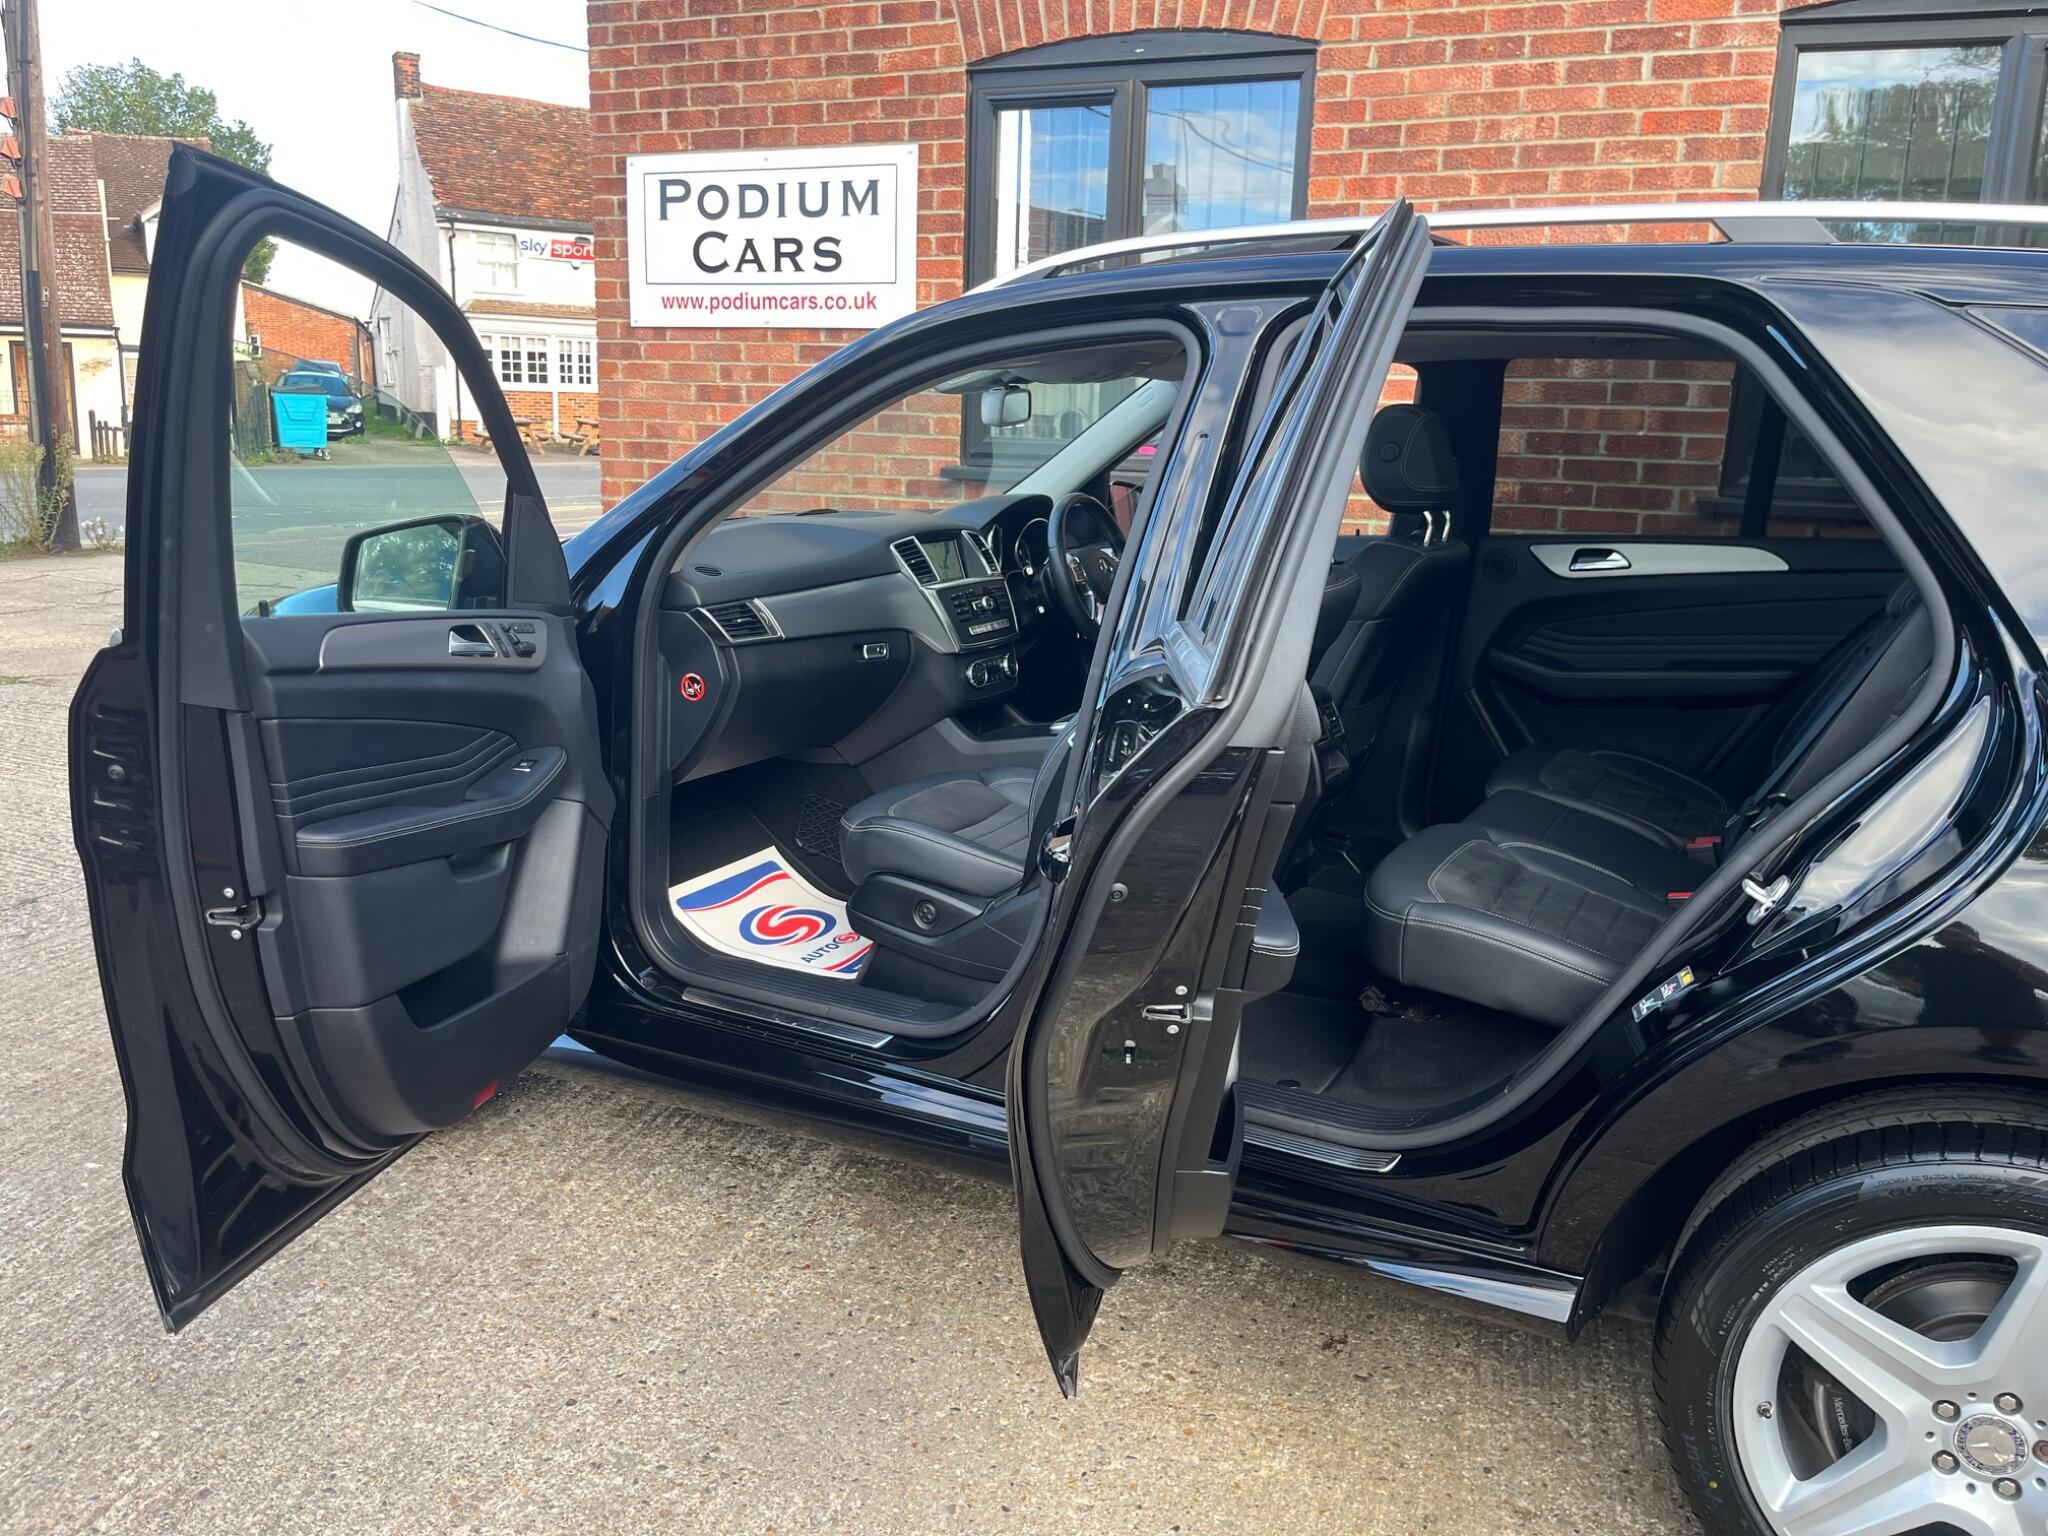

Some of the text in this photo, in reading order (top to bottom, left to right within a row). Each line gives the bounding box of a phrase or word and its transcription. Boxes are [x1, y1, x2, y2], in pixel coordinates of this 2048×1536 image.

[658, 178, 880, 221] PODIUM
[520, 238, 548, 256] sky
[692, 231, 843, 274] CARS
[661, 291, 878, 314] www.podiumcars.co.uk
